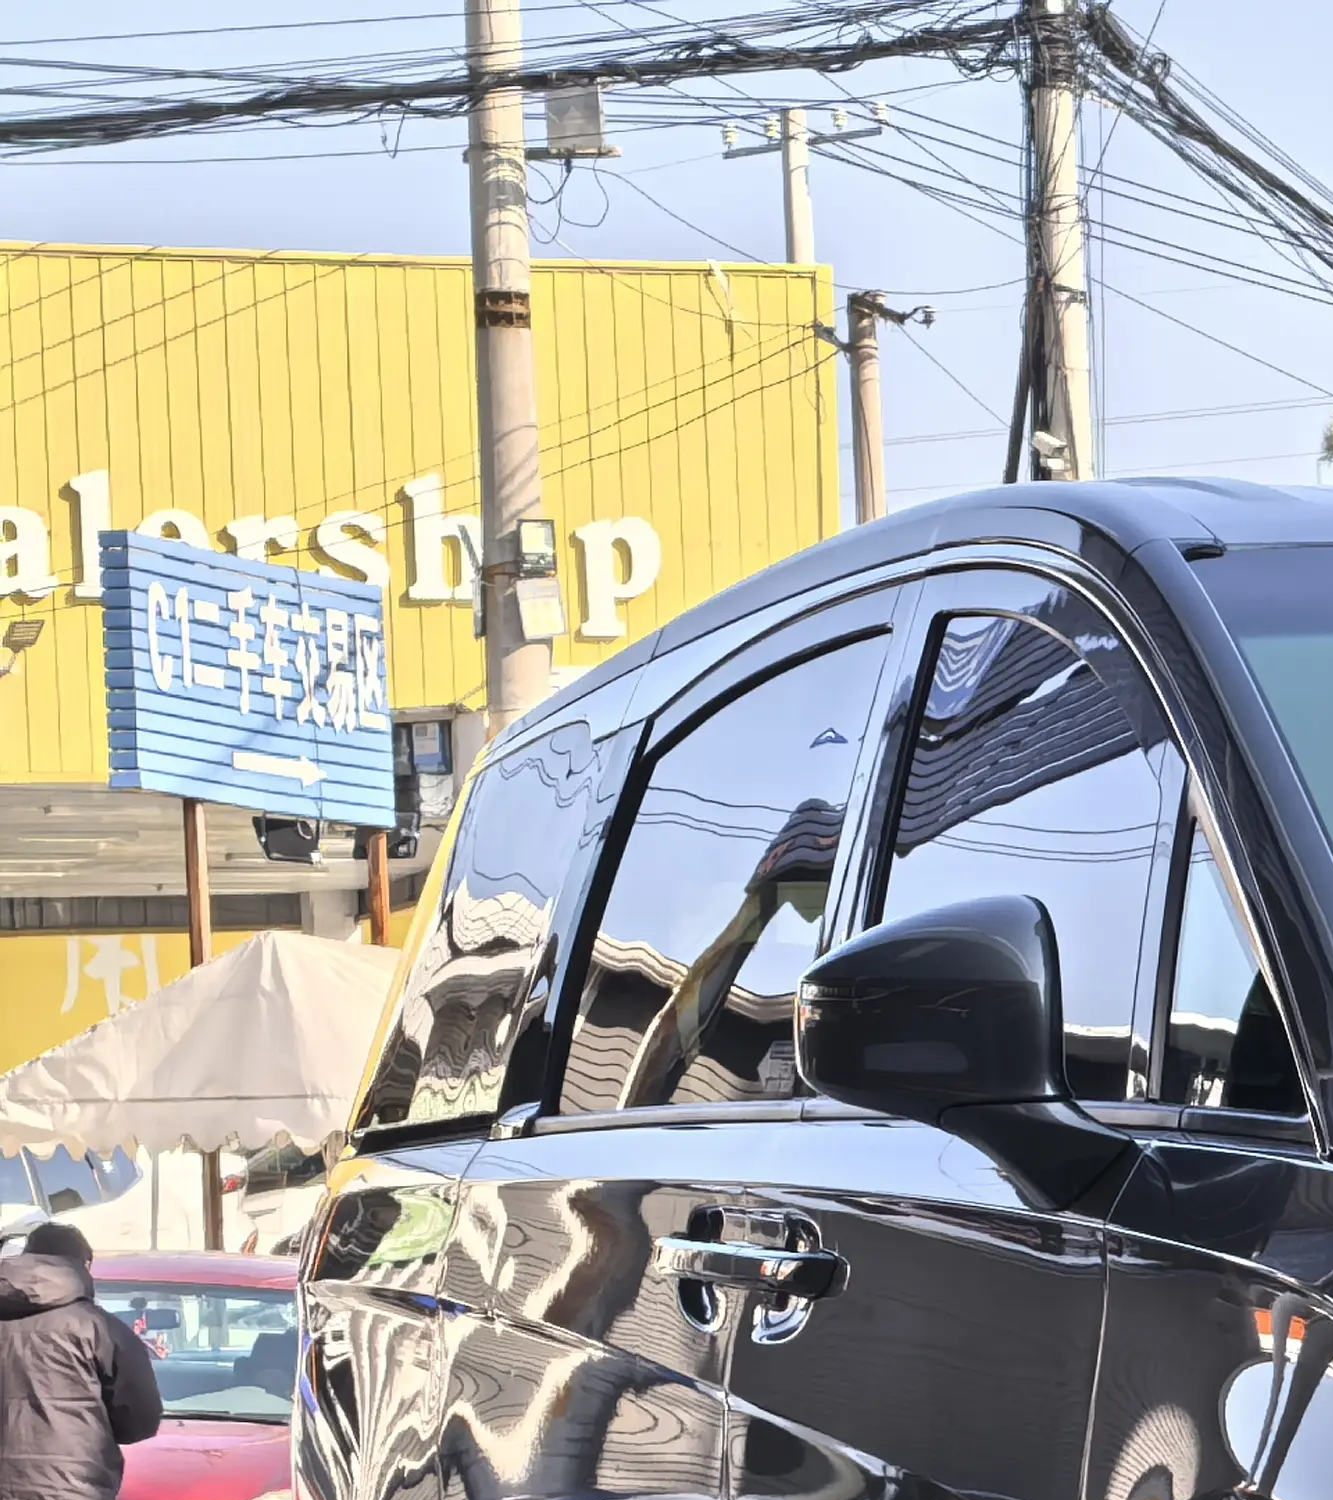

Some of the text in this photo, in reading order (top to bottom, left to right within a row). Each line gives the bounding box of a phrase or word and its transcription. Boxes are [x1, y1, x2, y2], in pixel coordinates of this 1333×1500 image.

[147, 580, 388, 735] C1二手车交易区
